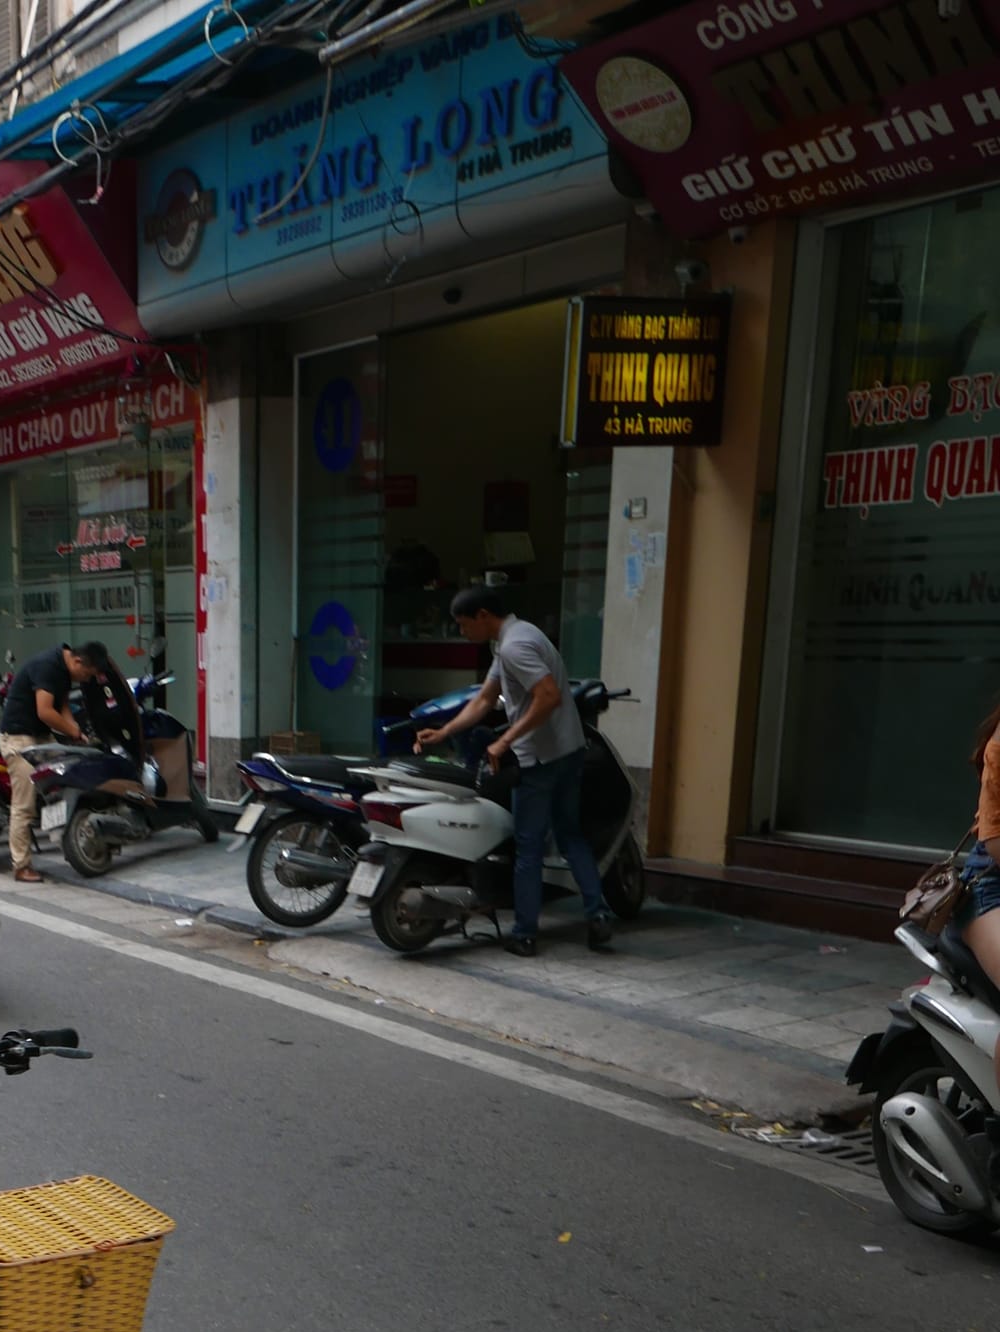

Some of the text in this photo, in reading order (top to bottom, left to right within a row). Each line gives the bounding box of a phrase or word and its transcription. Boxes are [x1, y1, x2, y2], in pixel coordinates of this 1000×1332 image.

[696, 0, 798, 50] CÔNG
[401, 64, 563, 176] LONG
[509, 125, 573, 166] TRUNG
[681, 152, 754, 202] GIỮ
[761, 123, 858, 180] CHỮ
[863, 103, 955, 153] TÍN
[818, 177, 838, 198] 43
[838, 169, 868, 193] HÀ
[866, 154, 936, 185] TRUNG
[8, 306, 49, 352] GIỮ
[40, 292, 105, 340] VÀNG
[614, 308, 643, 341] VÀNG
[643, 313, 667, 345] BẠC
[586, 351, 718, 416] THỊNH QUANG
[848, 379, 931, 428] VÀNG
[17, 409, 64, 451] CHÀO
[69, 391, 109, 439] QUÝ
[603, 411, 695, 437] 43 HÀ TRUNG
[823, 443, 919, 520] THỊNH
